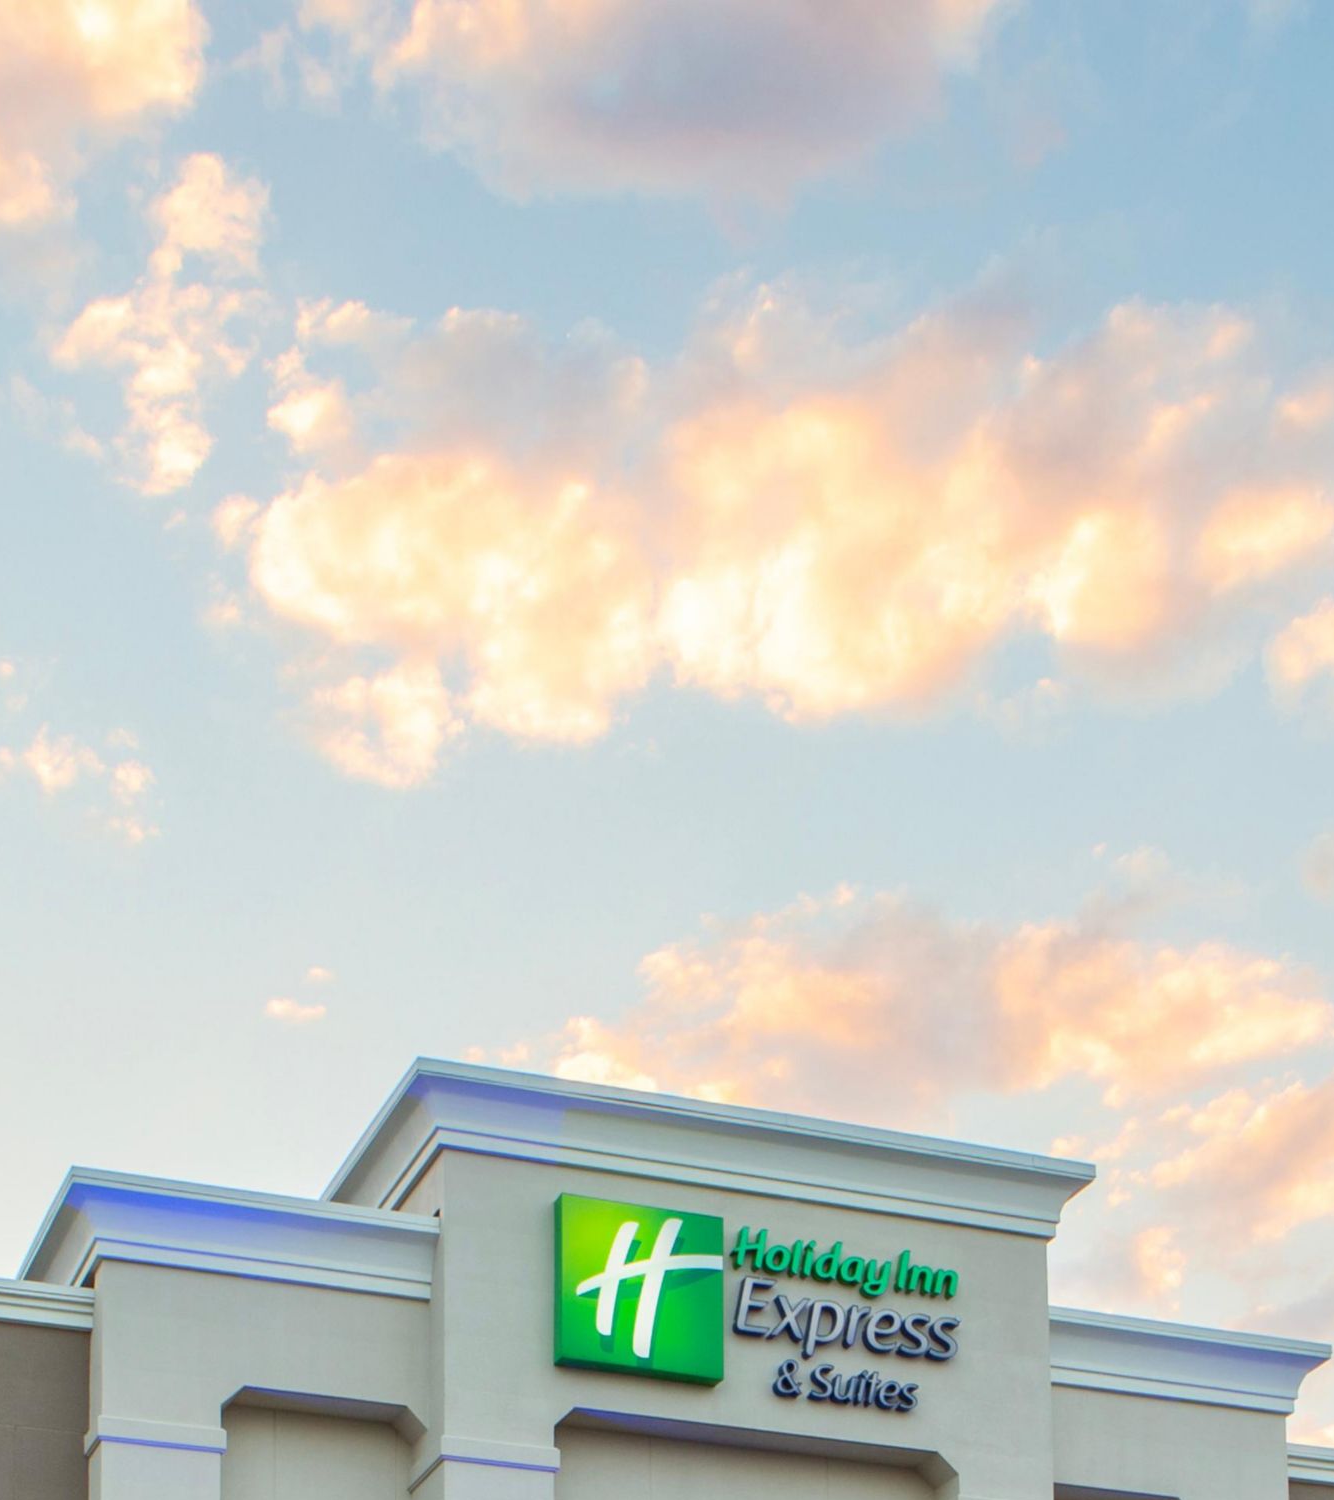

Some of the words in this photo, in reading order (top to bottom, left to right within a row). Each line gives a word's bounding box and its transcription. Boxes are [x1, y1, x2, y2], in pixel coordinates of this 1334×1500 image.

[730, 1226, 891, 1299] Holiday
[894, 1250, 959, 1300] Inn
[732, 1276, 962, 1361] Express
[772, 1359, 802, 1398] &
[807, 1364, 918, 1412] Suites
